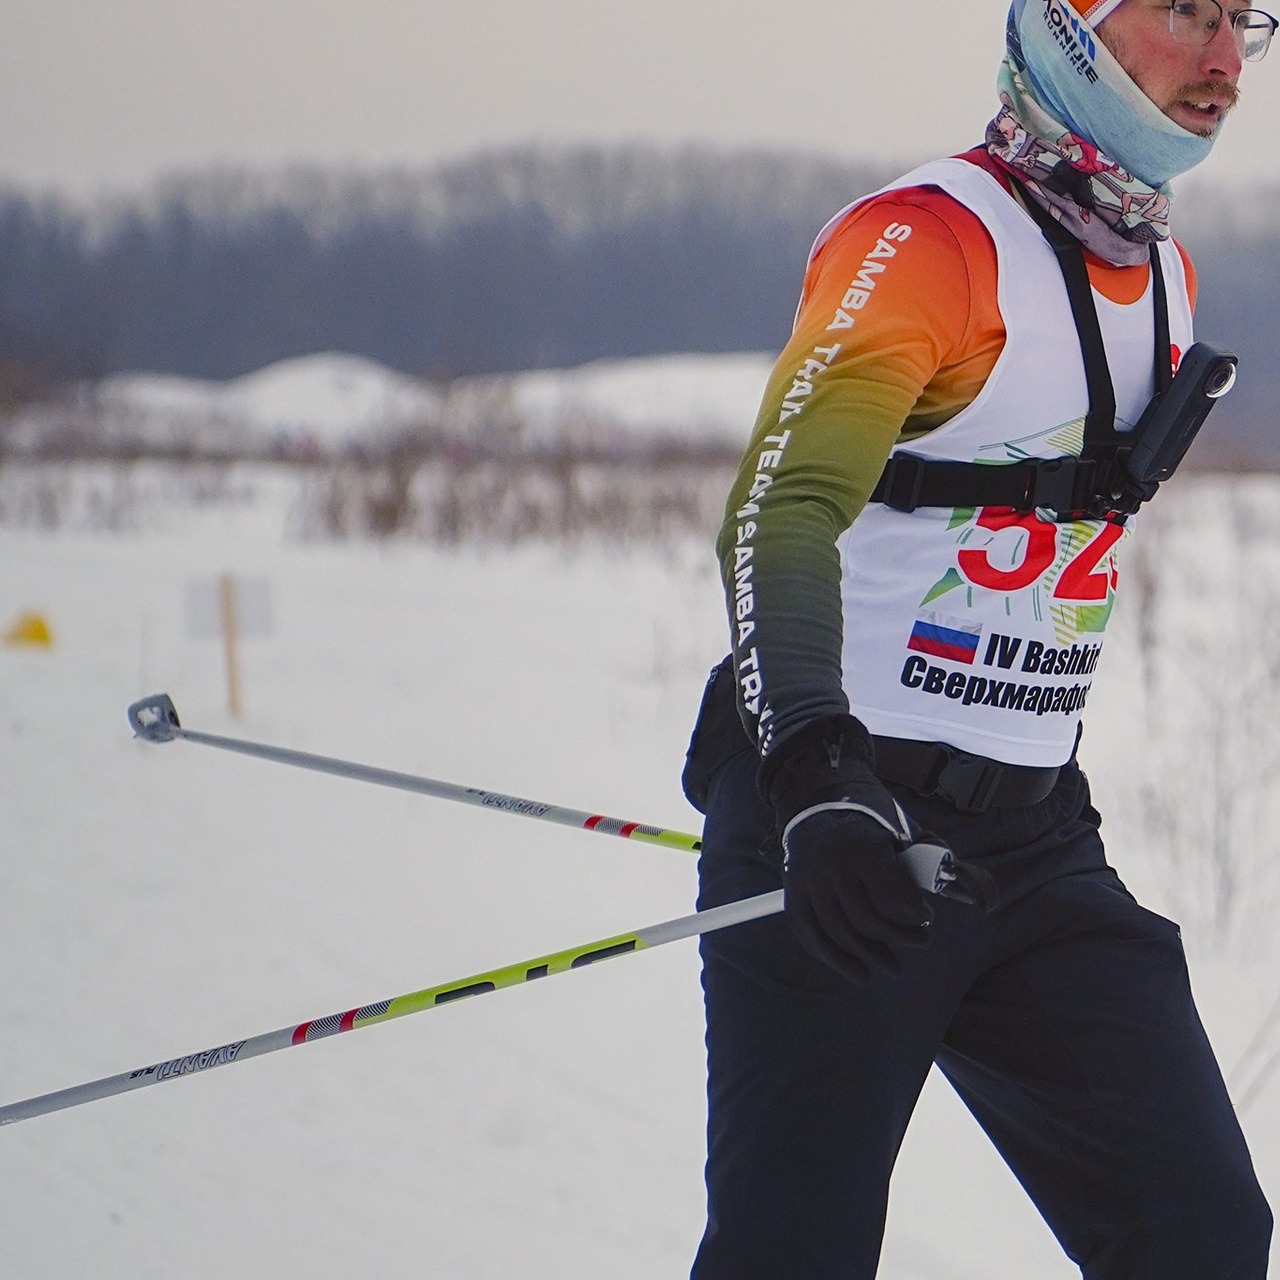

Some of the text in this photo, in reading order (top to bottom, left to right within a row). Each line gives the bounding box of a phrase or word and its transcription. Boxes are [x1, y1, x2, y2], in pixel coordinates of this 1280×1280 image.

[1043, 11, 1083, 75] RUNNING
[825, 221, 912, 332] SAMBA
[734, 521, 757, 648] SAMBA
[957, 505, 1119, 600] 52
[983, 632, 1103, 676] IV Bashkir
[157, 1040, 247, 1081] AVANTI
